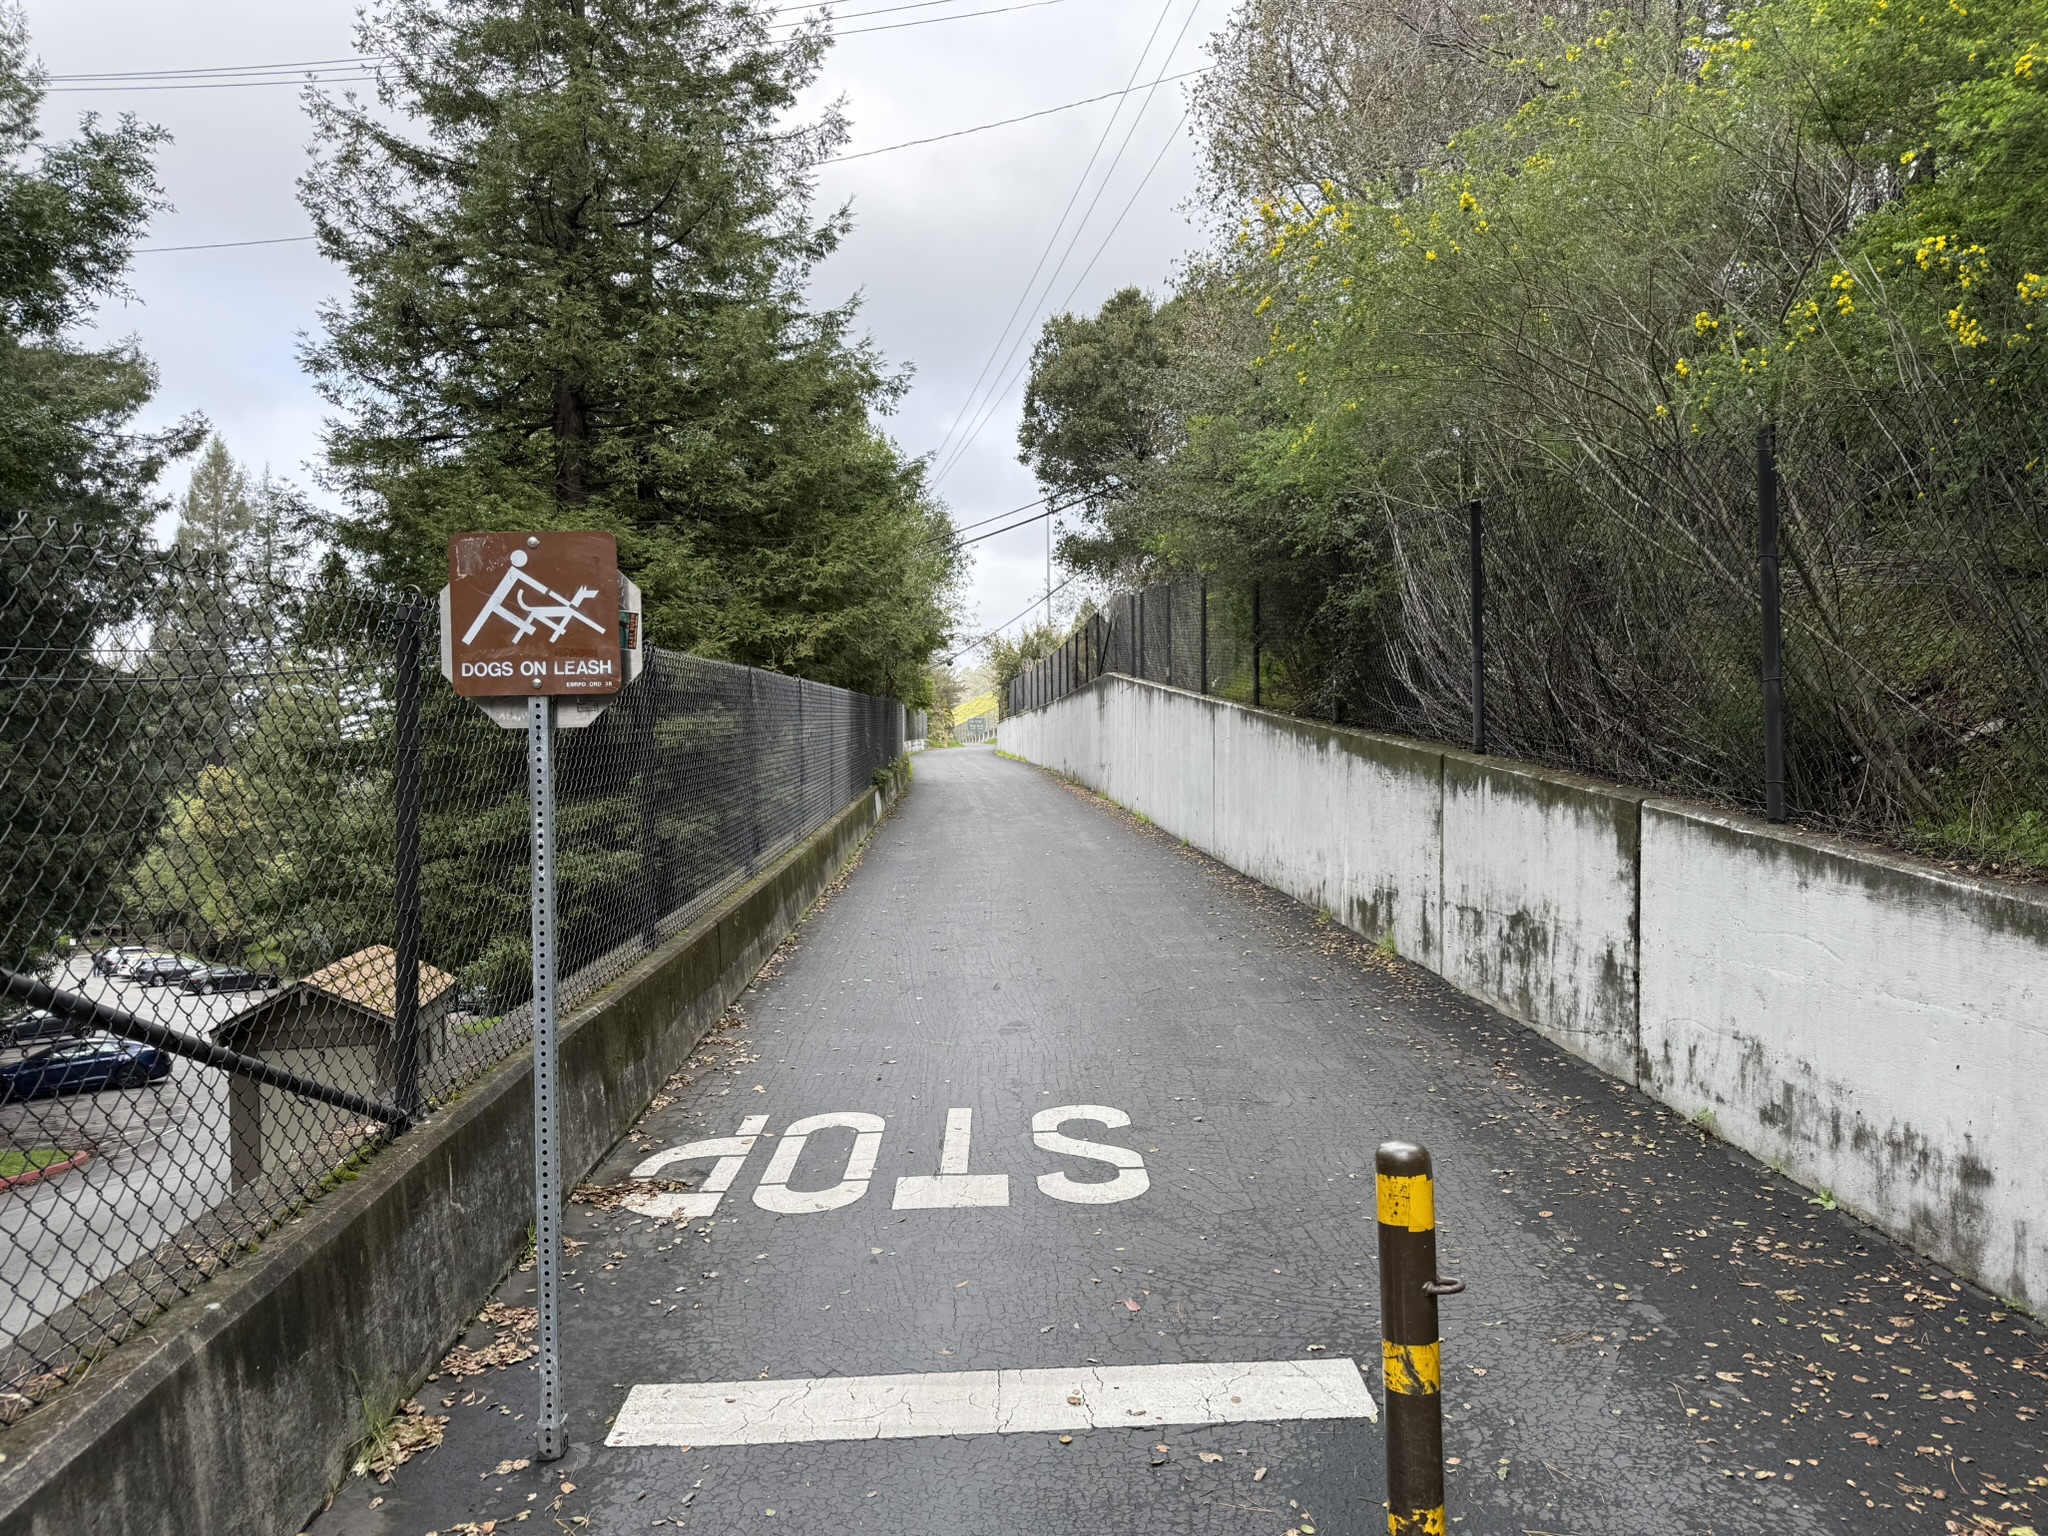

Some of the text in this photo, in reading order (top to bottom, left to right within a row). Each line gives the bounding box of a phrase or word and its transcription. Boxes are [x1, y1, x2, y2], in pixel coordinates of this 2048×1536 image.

[461, 659, 612, 677] DOGS ON LEASH
[619, 1104, 1150, 1217] STOP
